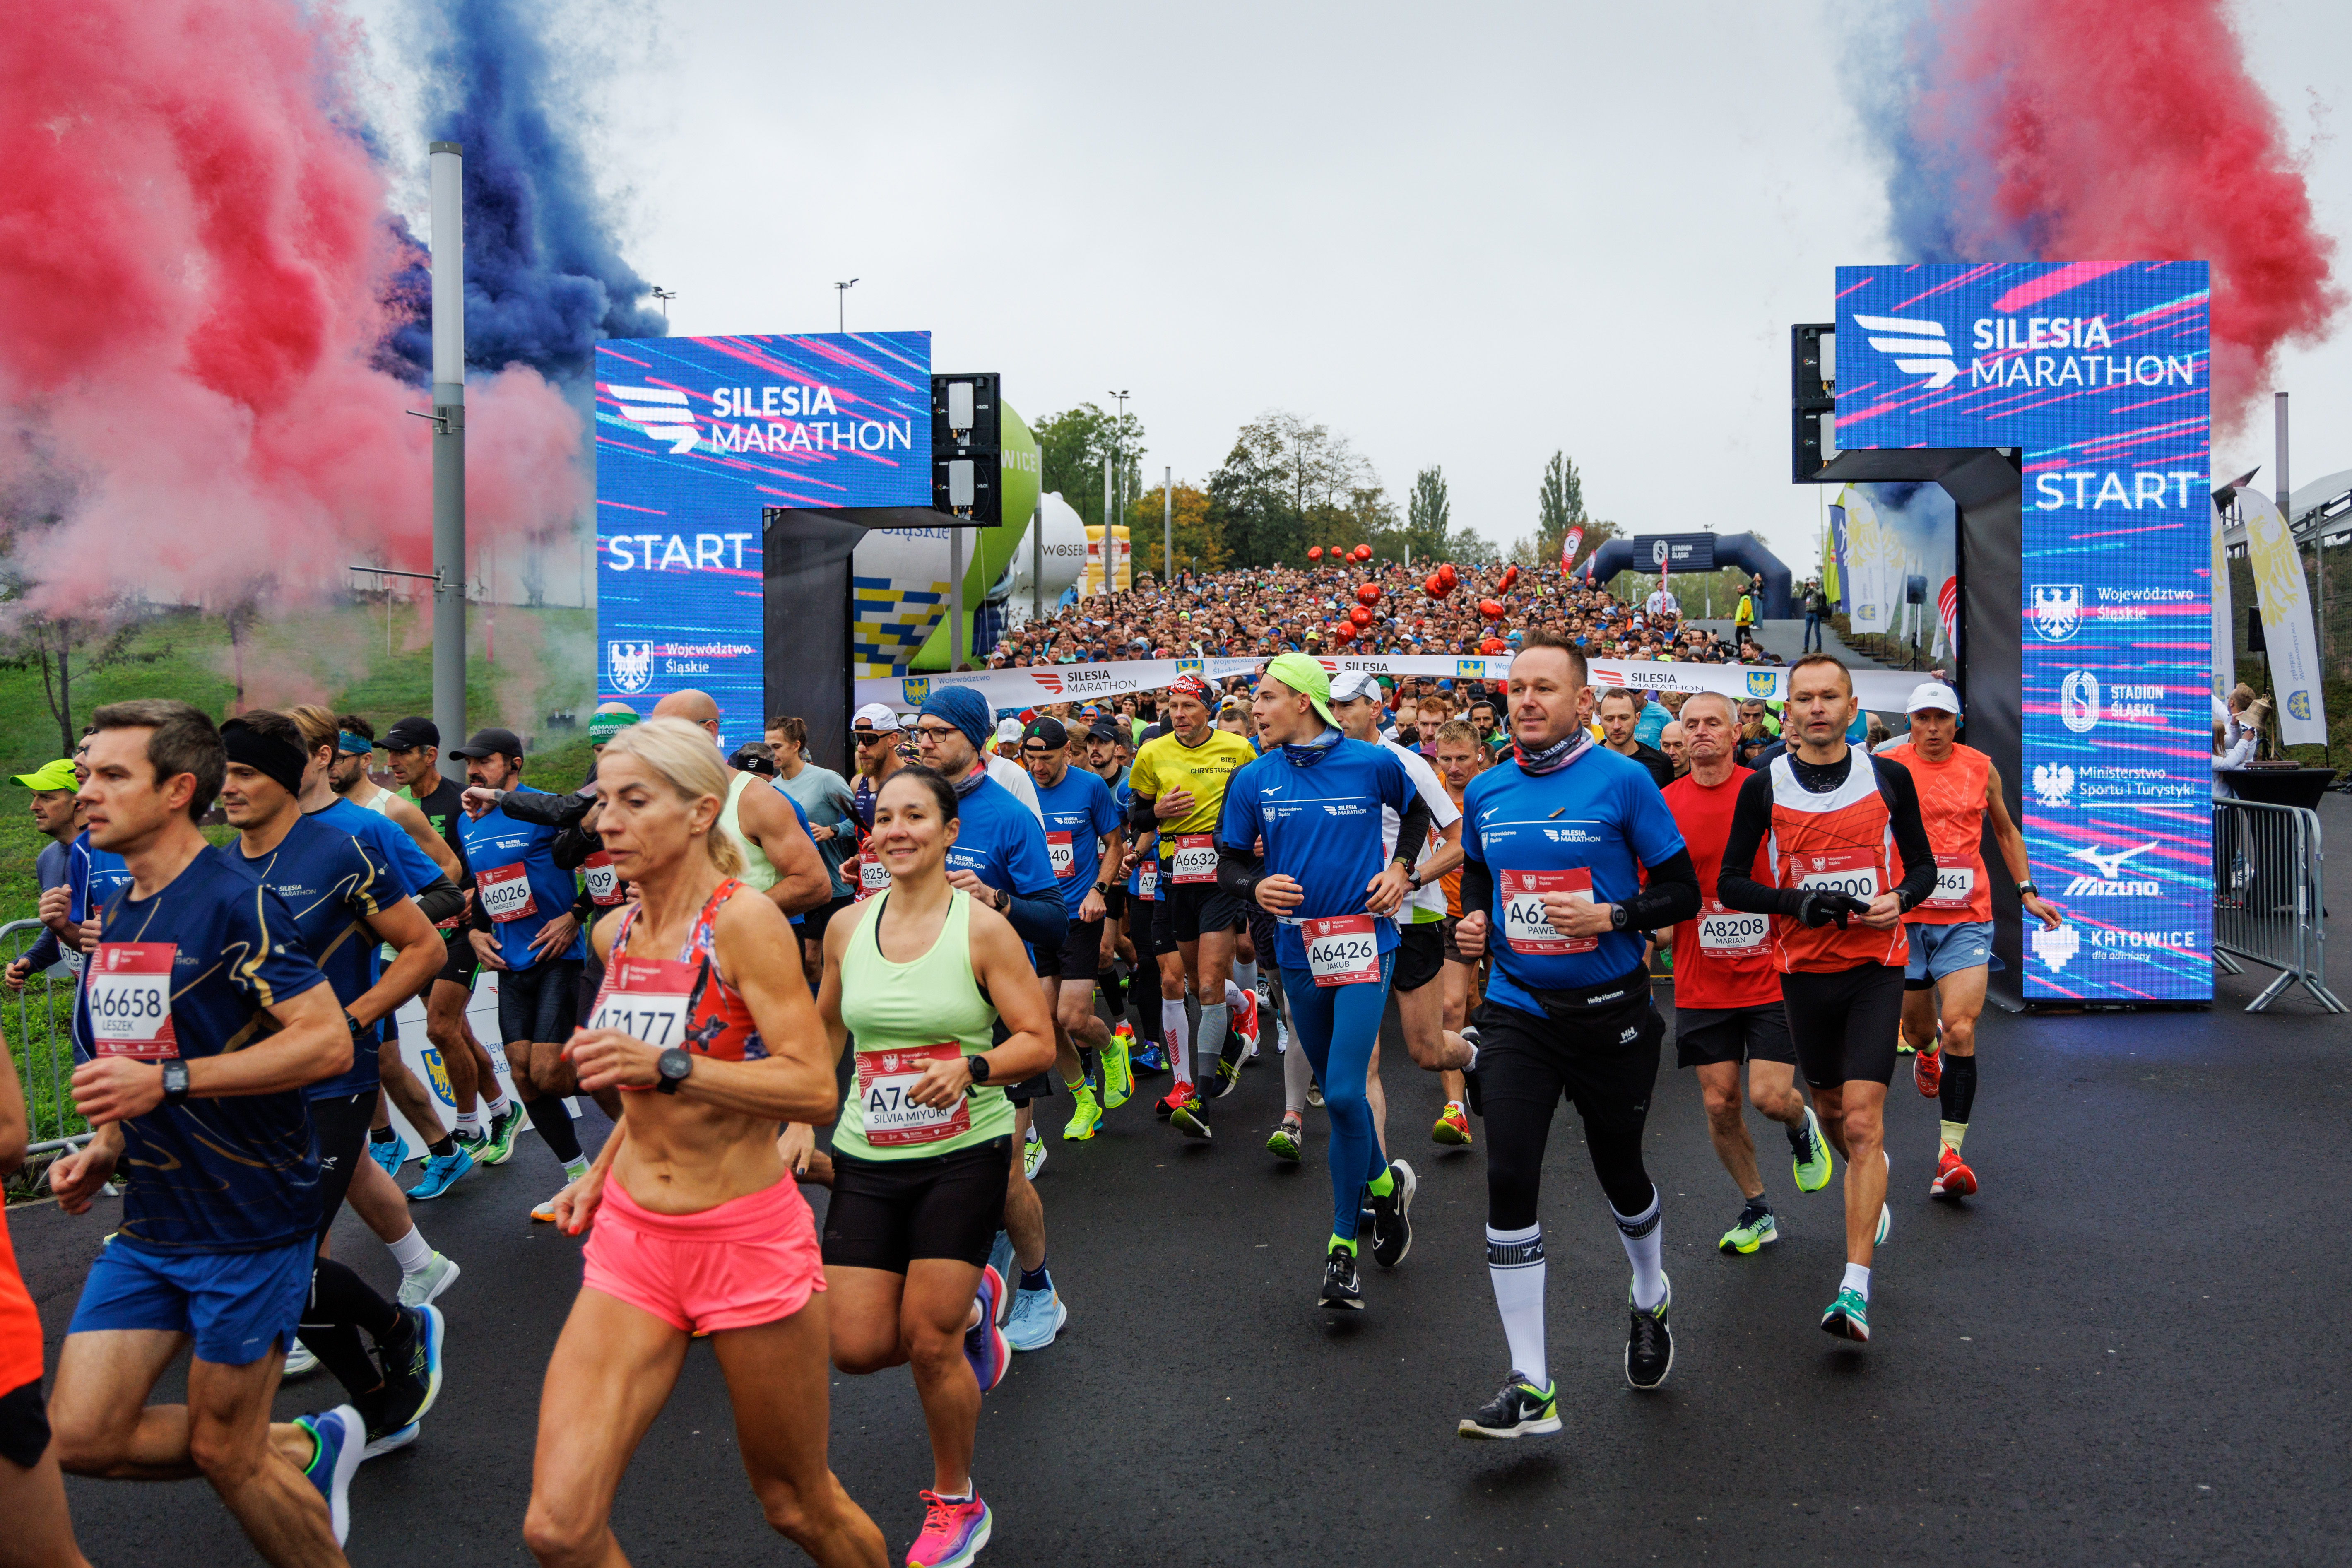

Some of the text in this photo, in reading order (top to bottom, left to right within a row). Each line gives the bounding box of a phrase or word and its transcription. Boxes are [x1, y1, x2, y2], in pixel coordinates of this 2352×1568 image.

[1973, 317, 2112, 350] SILESIA
[1972, 356, 2192, 388] MARATHON
[712, 386, 837, 417] SILESIA
[712, 421, 911, 452] MARATHON
[2035, 470, 2198, 510] START
[609, 533, 753, 571] START
[2097, 585, 2194, 604] Województwo
[2097, 605, 2147, 622] Śląskie
[665, 642, 751, 658] Województwo
[665, 658, 709, 676] Śląskie
[1345, 662, 1389, 672] SILESIA
[938, 674, 990, 684] Województwo
[1068, 670, 1110, 682] SILESIA
[1632, 672, 1677, 683] SILESIA
[1068, 679, 1136, 693] MARATHON
[1631, 682, 1704, 692] MARATHON
[2111, 686, 2164, 700] STADION
[2111, 701, 2154, 722] ŚLĄSKI
[2080, 766, 2166, 781] Ministerstwo
[2080, 782, 2195, 799] Sportu i Turystyki
[954, 854, 974, 862] SILESIA
[1049, 849, 1069, 862] 40
[1175, 853, 1216, 867] A6632
[953, 860, 985, 870] MARATHON
[585, 872, 611, 887] 409
[1936, 874, 1967, 889] 461
[484, 883, 527, 906] A6026
[493, 901, 515, 911] ANDRZEJ
[1703, 918, 1764, 937] A8208
[2091, 930, 2195, 949] KATOWICE
[1312, 940, 1372, 964] A6426
[2092, 951, 2151, 963] dla odmiany
[1327, 961, 1350, 971] JAKUB
[91, 988, 161, 1018] A6658
[103, 1020, 134, 1031] LESZEK
[874, 1113, 904, 1124] SILVIA
